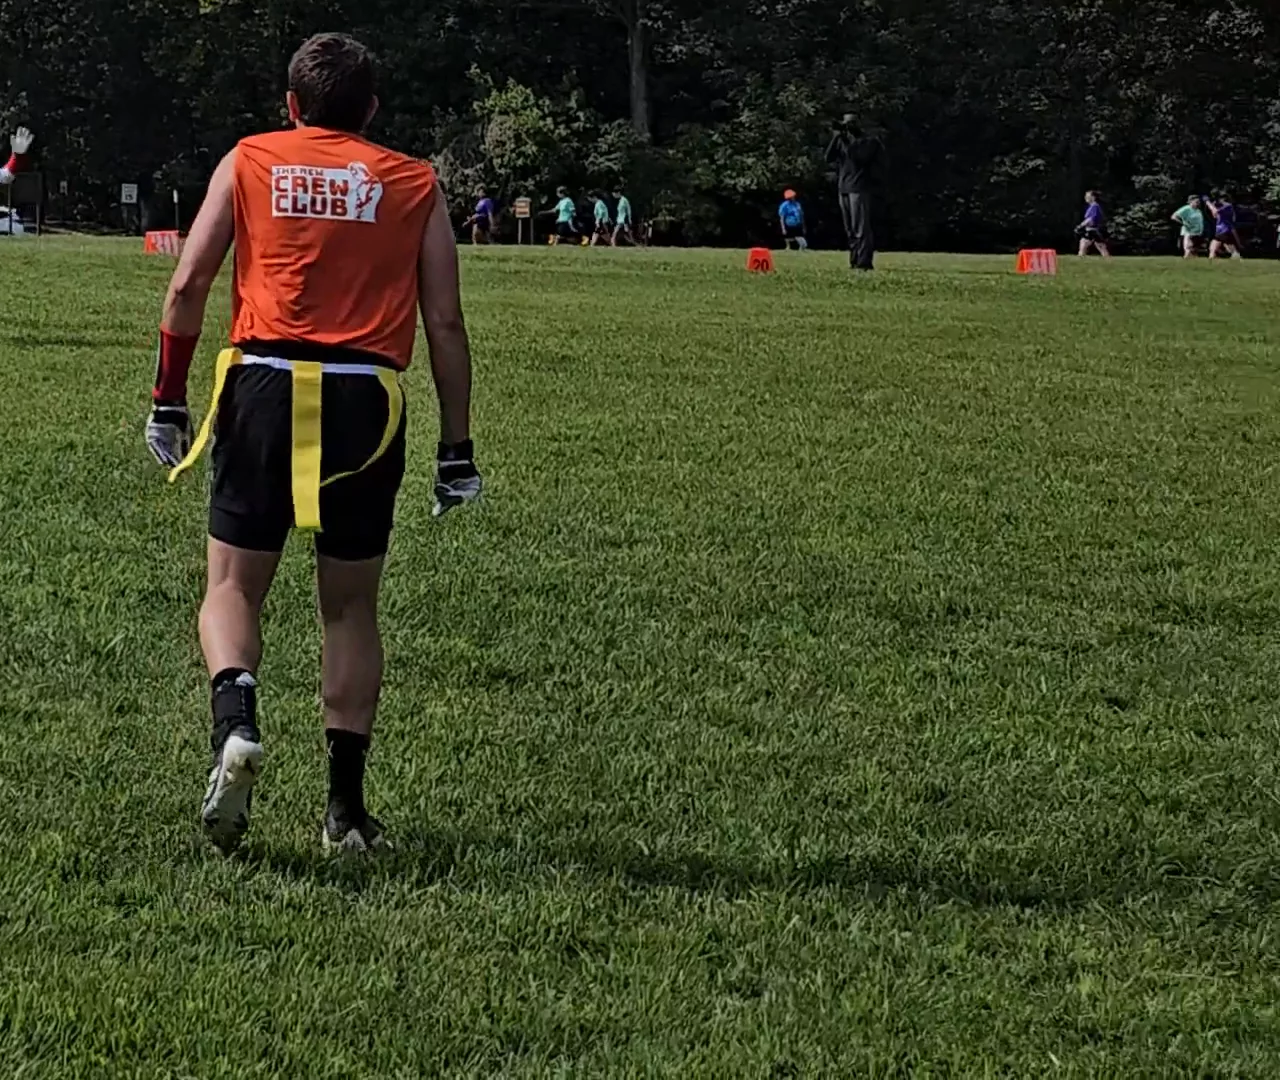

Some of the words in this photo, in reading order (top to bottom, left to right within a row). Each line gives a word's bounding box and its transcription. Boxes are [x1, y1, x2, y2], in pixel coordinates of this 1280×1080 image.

[275, 176, 349, 196] CREW
[275, 195, 348, 217] CLUB
[753, 258, 770, 272] 20
